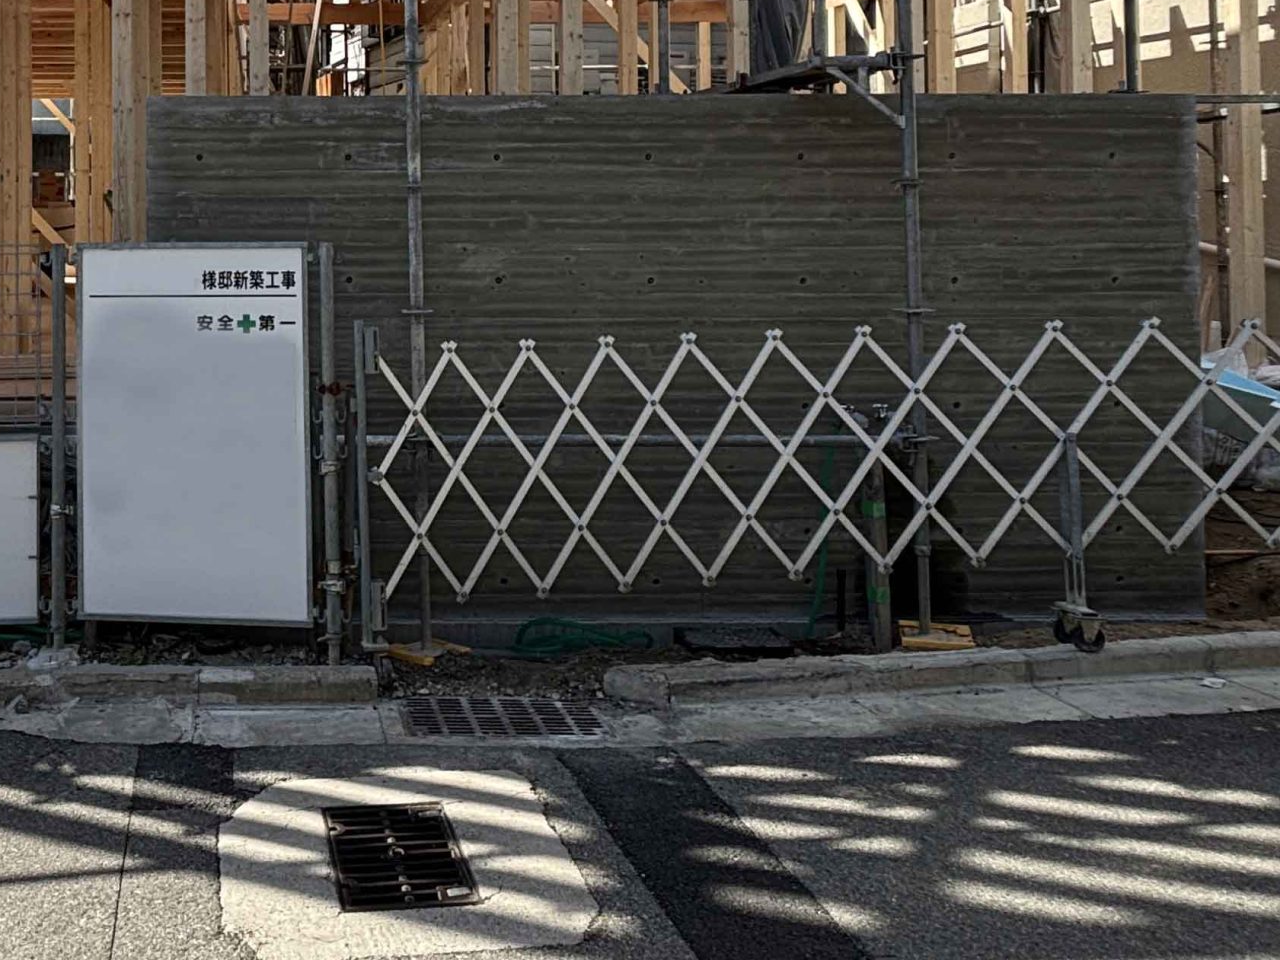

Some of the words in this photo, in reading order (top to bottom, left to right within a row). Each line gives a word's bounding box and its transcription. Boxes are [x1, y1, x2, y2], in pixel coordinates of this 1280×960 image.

[201, 270, 296, 290] 様邸新築工事
